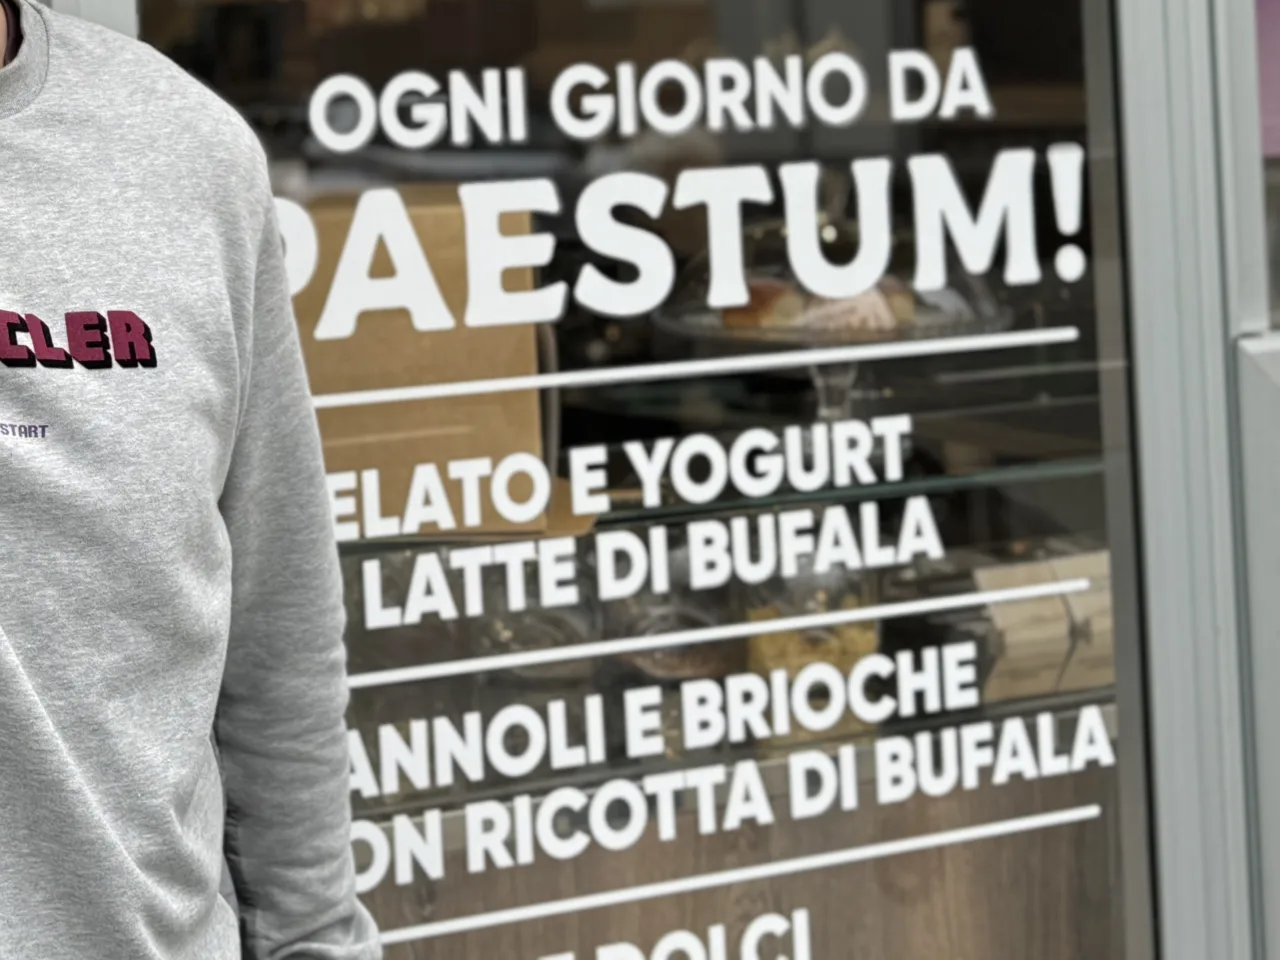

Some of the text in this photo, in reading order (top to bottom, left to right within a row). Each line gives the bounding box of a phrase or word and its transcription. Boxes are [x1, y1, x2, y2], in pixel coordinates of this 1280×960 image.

[307, 46, 994, 153] OGNI GIORNO DA
[0, 422, 49, 439] START
[325, 414, 913, 542] ELATO E YOGURT
[362, 496, 945, 630] LATTE DI BUFALA
[347, 641, 980, 799] ANNOLI E BRIOCHE
[350, 704, 1117, 895] ON RICOTTA DI BUFALA
